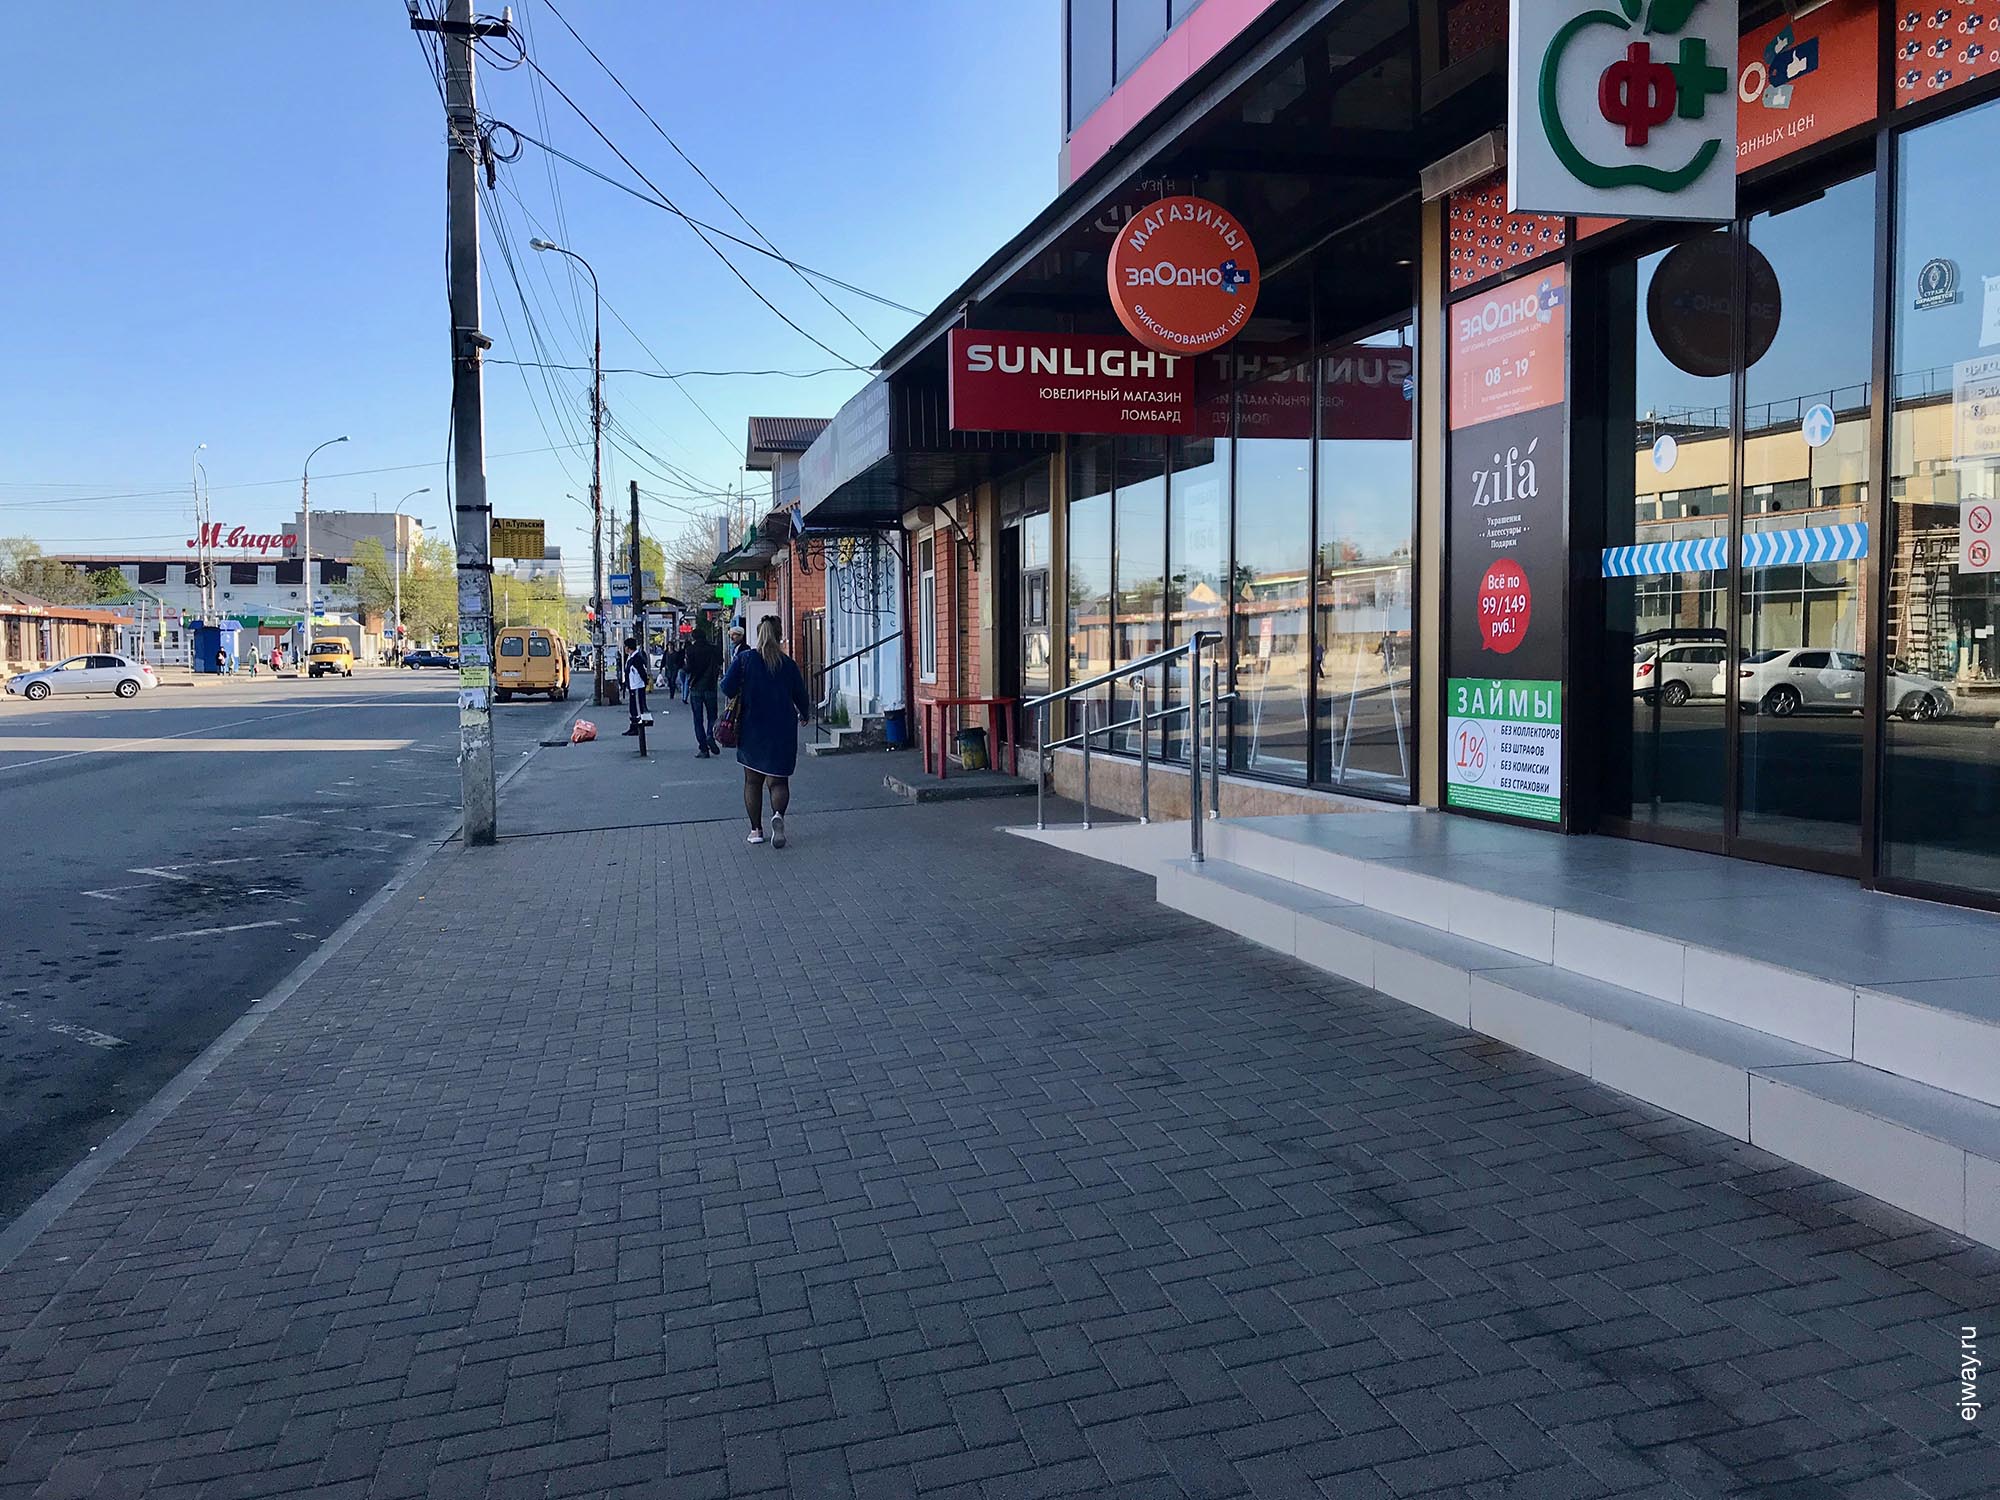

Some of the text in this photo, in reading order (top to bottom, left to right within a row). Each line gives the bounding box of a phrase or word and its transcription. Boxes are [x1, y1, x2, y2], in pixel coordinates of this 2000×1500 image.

[1788, 114, 1815, 138] цен
[1128, 203, 1244, 253] МАГАЗИНЫ
[1134, 303, 1247, 345] ФИКСИРОВАННЫХ ЦЕН
[967, 344, 1181, 378] SUNLIGHT
[1485, 366, 1501, 387] 08
[1515, 358, 1528, 378] 19
[1039, 387, 1182, 402] ЮВЕЛИРНЫЙ МАГАЗИН
[1120, 409, 1182, 423] ЛОМБАРД
[1472, 437, 1539, 507] zifá
[492, 519, 501, 529] А
[1487, 514, 1521, 526] Украшения
[1486, 526, 1522, 538] Аксессуары
[1490, 538, 1517, 549] Подарки
[1488, 574, 1520, 590] Всё по
[1482, 594, 1526, 616] 99/149
[1492, 617, 1516, 637] руб.!
[1457, 680, 1552, 719] ЗАЙМЫ
[1500, 725, 1560, 740] БЕЗ КОЛЛЕКТОРОВ
[1456, 730, 1484, 768] 1%
[1500, 742, 1545, 757] БЕЗ ШТРАФОВ
[1500, 760, 1550, 775] БЕЗ КОМИССИИ
[1500, 777, 1550, 793] БЕЗ СТРАХОВКИ
